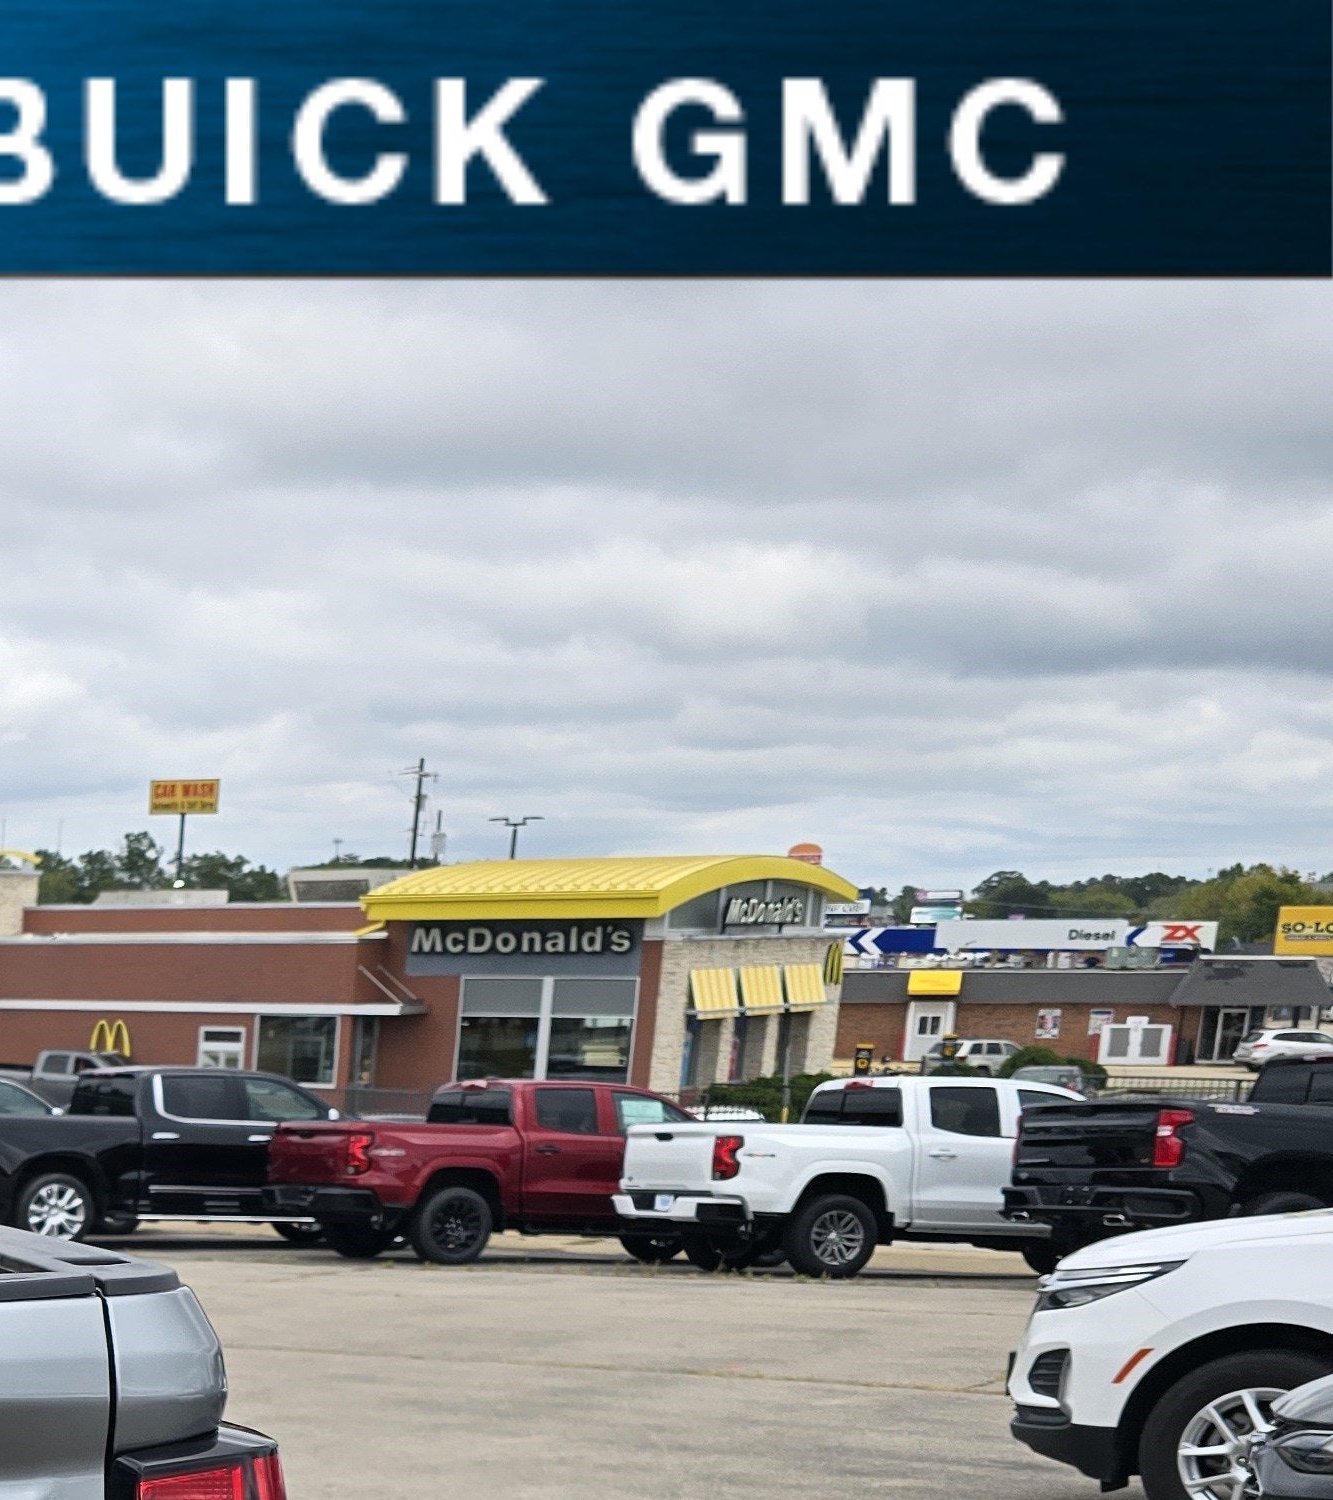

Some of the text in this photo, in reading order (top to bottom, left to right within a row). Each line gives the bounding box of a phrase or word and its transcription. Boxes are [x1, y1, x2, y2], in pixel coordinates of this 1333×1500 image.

[154, 783, 215, 799] CAR WASH
[410, 925, 632, 953] McDonald's
[1067, 929, 1116, 941] Diesel
